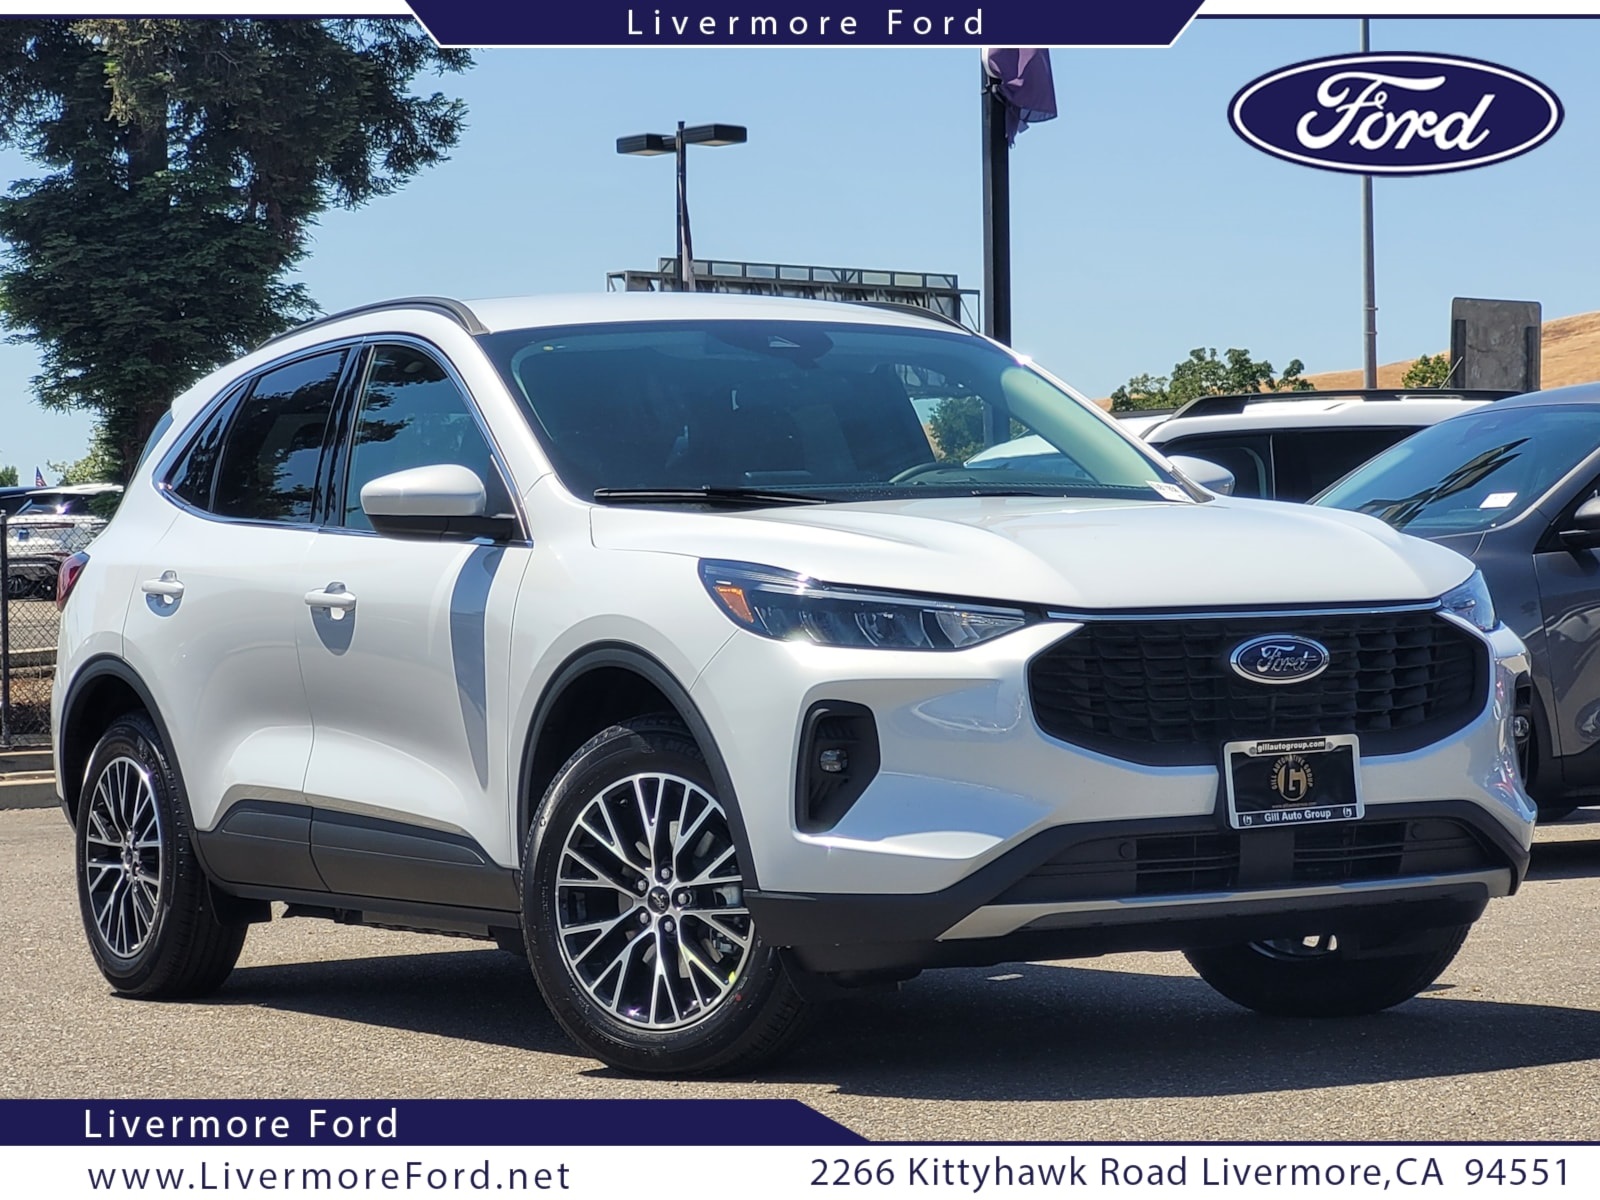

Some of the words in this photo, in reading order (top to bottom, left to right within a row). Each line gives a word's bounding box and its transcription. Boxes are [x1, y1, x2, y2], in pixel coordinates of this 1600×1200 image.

[1256, 645, 1312, 672] Ford
[1257, 741, 1325, 753] gillautogroup.com
[1303, 763, 1314, 788] GROUP
[1264, 812, 1279, 823] Gill
[1281, 810, 1302, 821] Auto
[1304, 809, 1331, 820] Group
